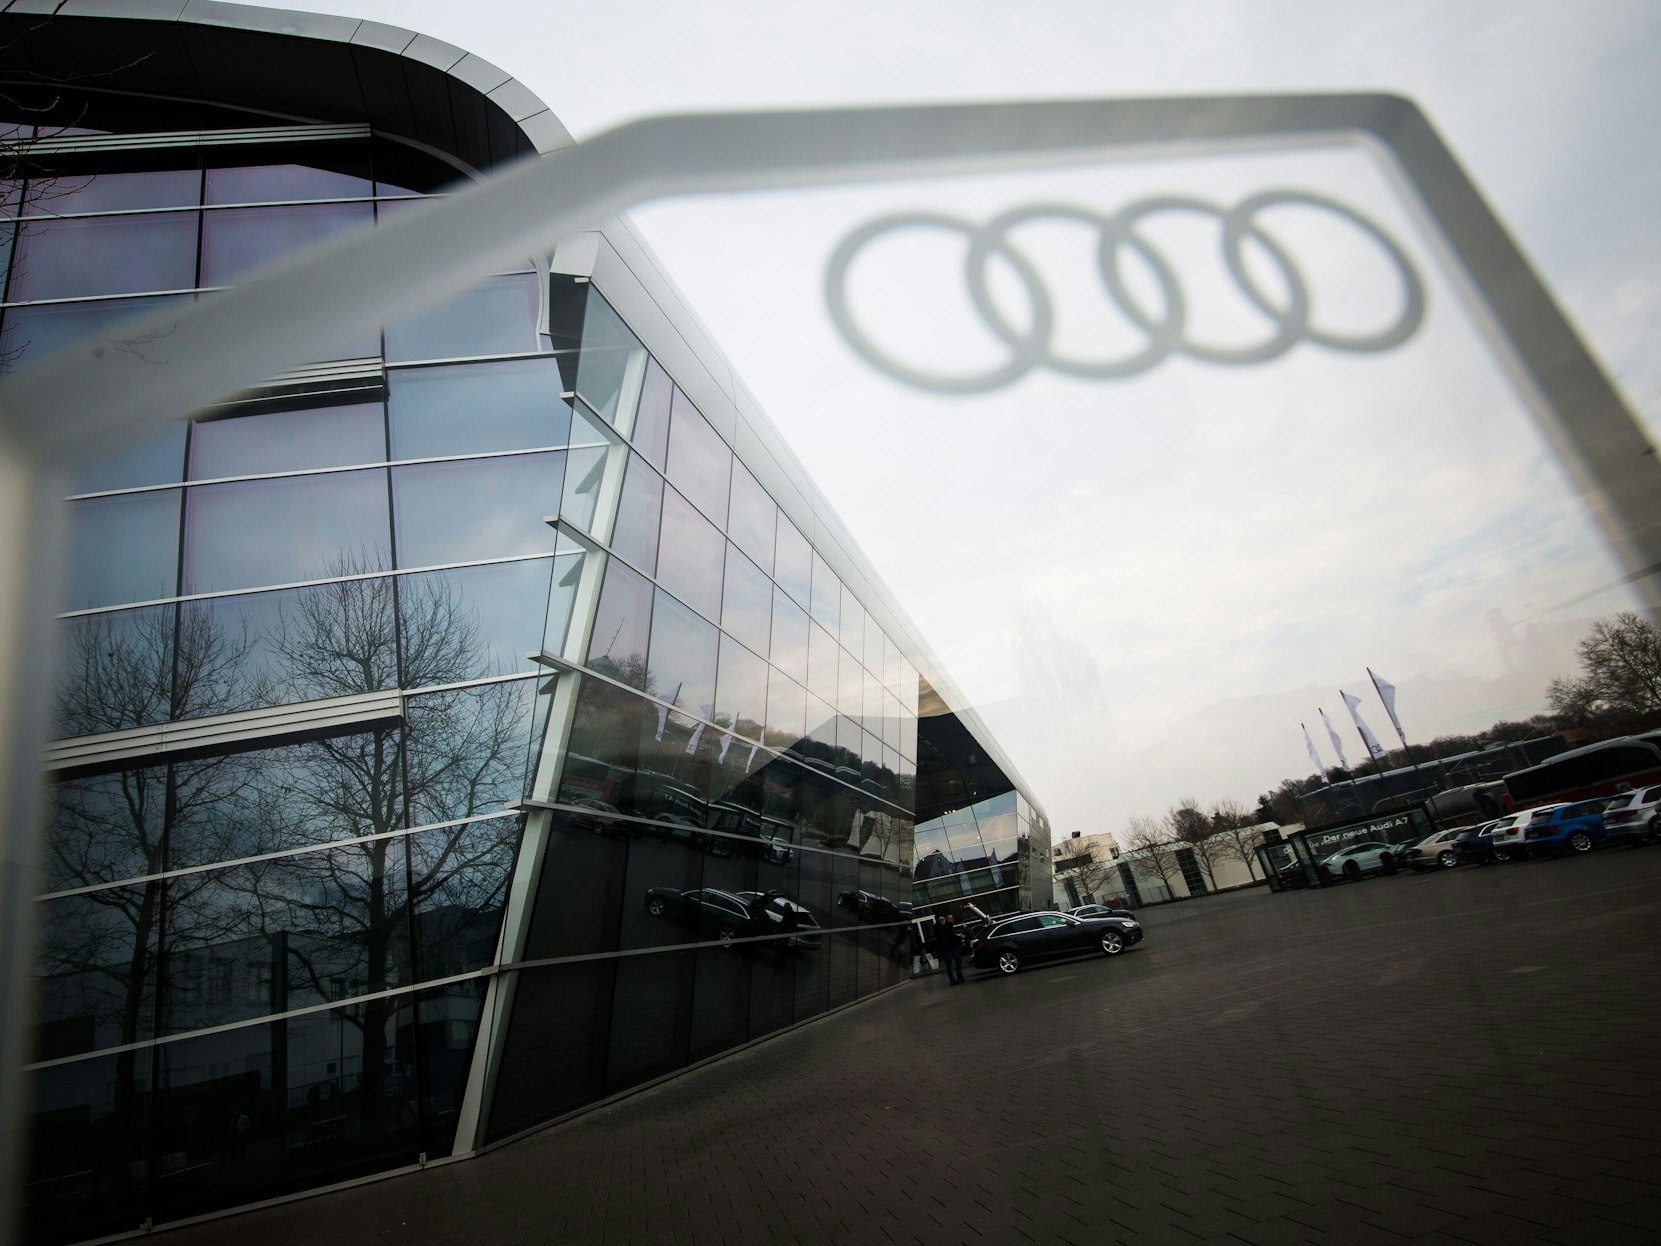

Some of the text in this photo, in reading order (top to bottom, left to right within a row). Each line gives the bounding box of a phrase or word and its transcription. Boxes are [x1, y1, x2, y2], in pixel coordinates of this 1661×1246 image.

[1323, 816, 1409, 843] Der neue Audi A7
